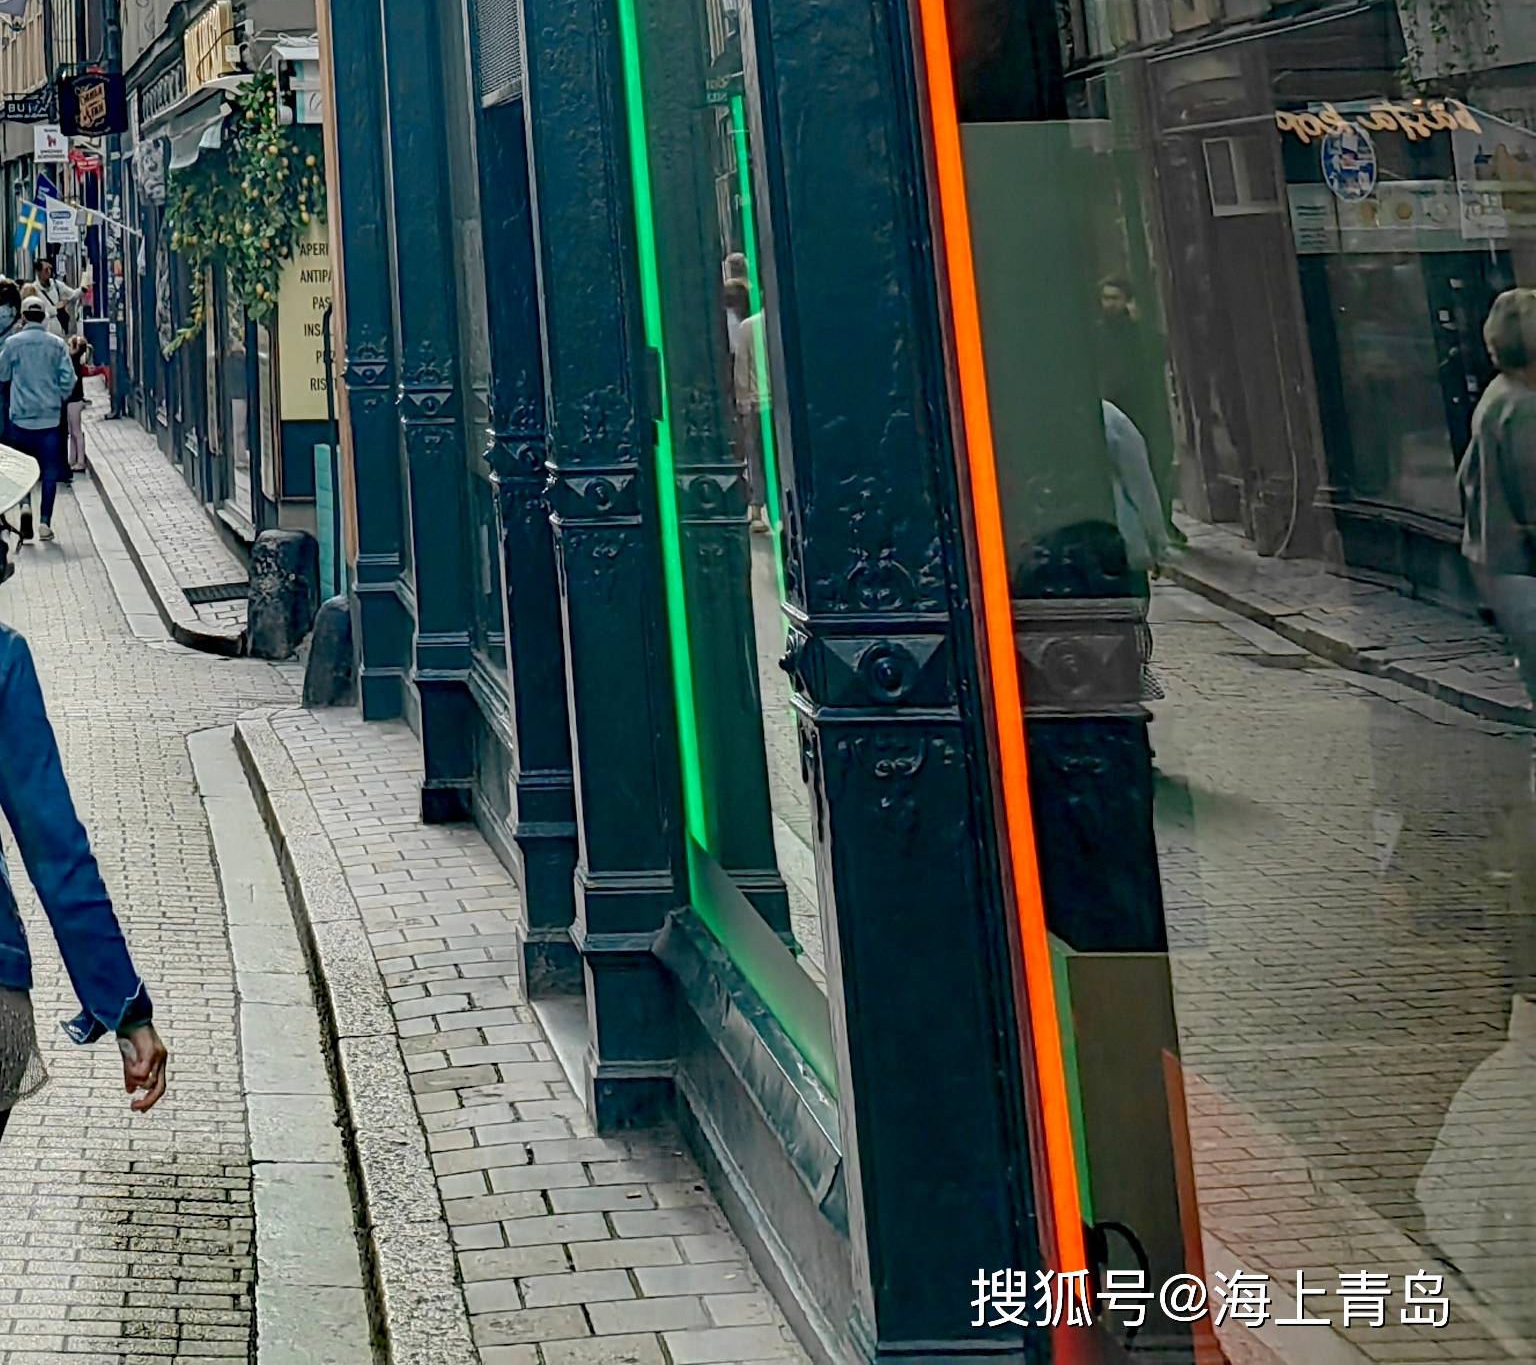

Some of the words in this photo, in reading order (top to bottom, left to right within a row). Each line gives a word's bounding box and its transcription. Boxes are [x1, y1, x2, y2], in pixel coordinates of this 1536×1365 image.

[300, 242, 328, 256] APERI
[312, 296, 331, 310] PAS
[304, 324, 333, 337] INS
